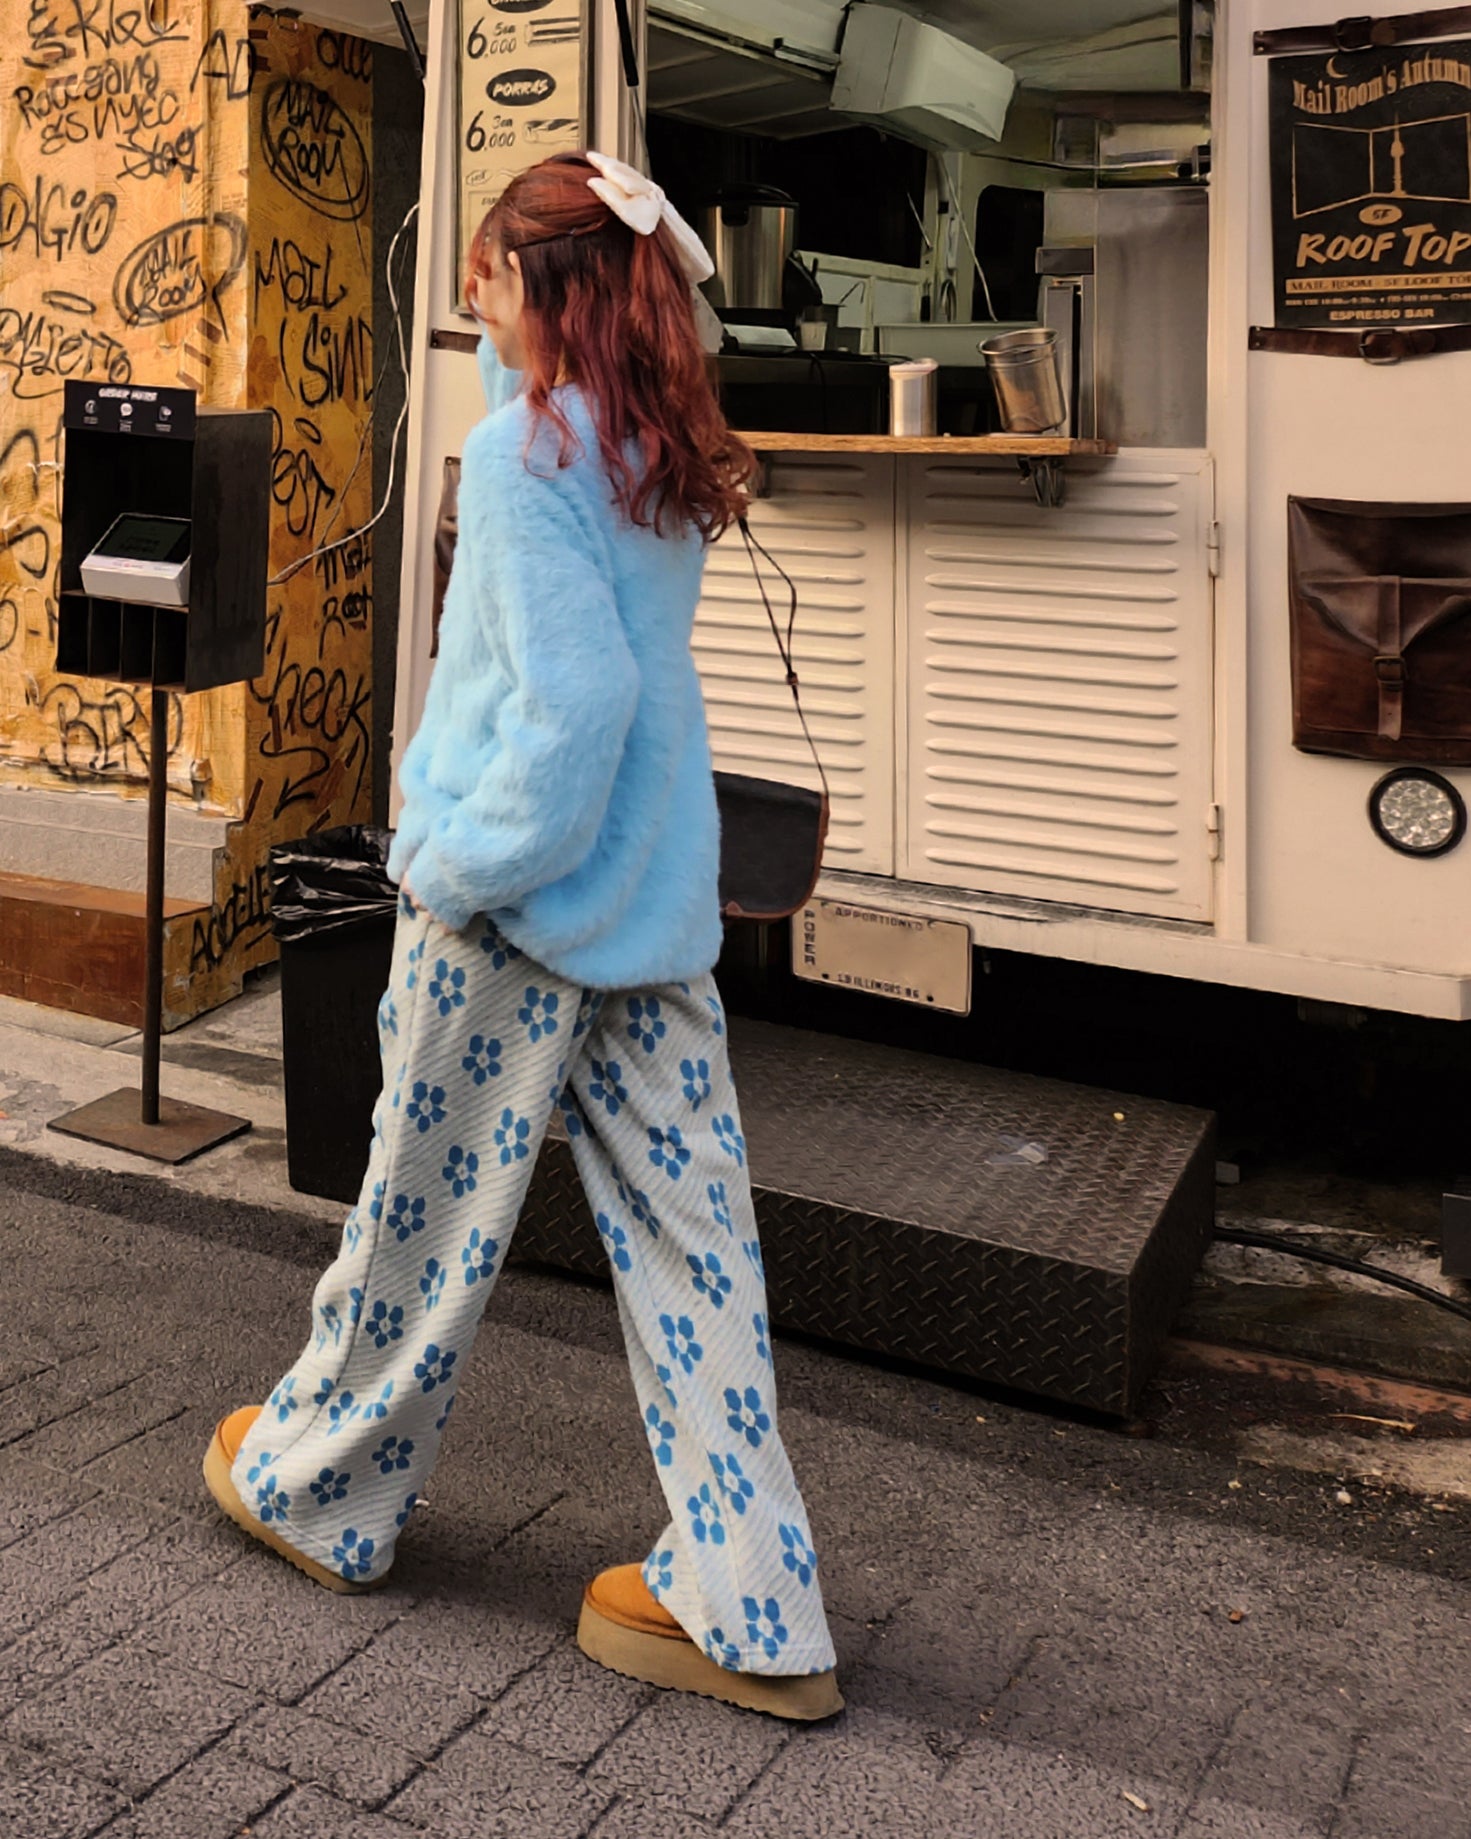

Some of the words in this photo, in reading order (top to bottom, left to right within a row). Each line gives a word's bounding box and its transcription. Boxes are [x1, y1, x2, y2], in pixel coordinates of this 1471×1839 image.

[1334, 65, 1398, 114] Room's
[1296, 231, 1397, 268] ROOF
[1402, 223, 1471, 267] TOP
[1404, 308, 1435, 318] BAR
